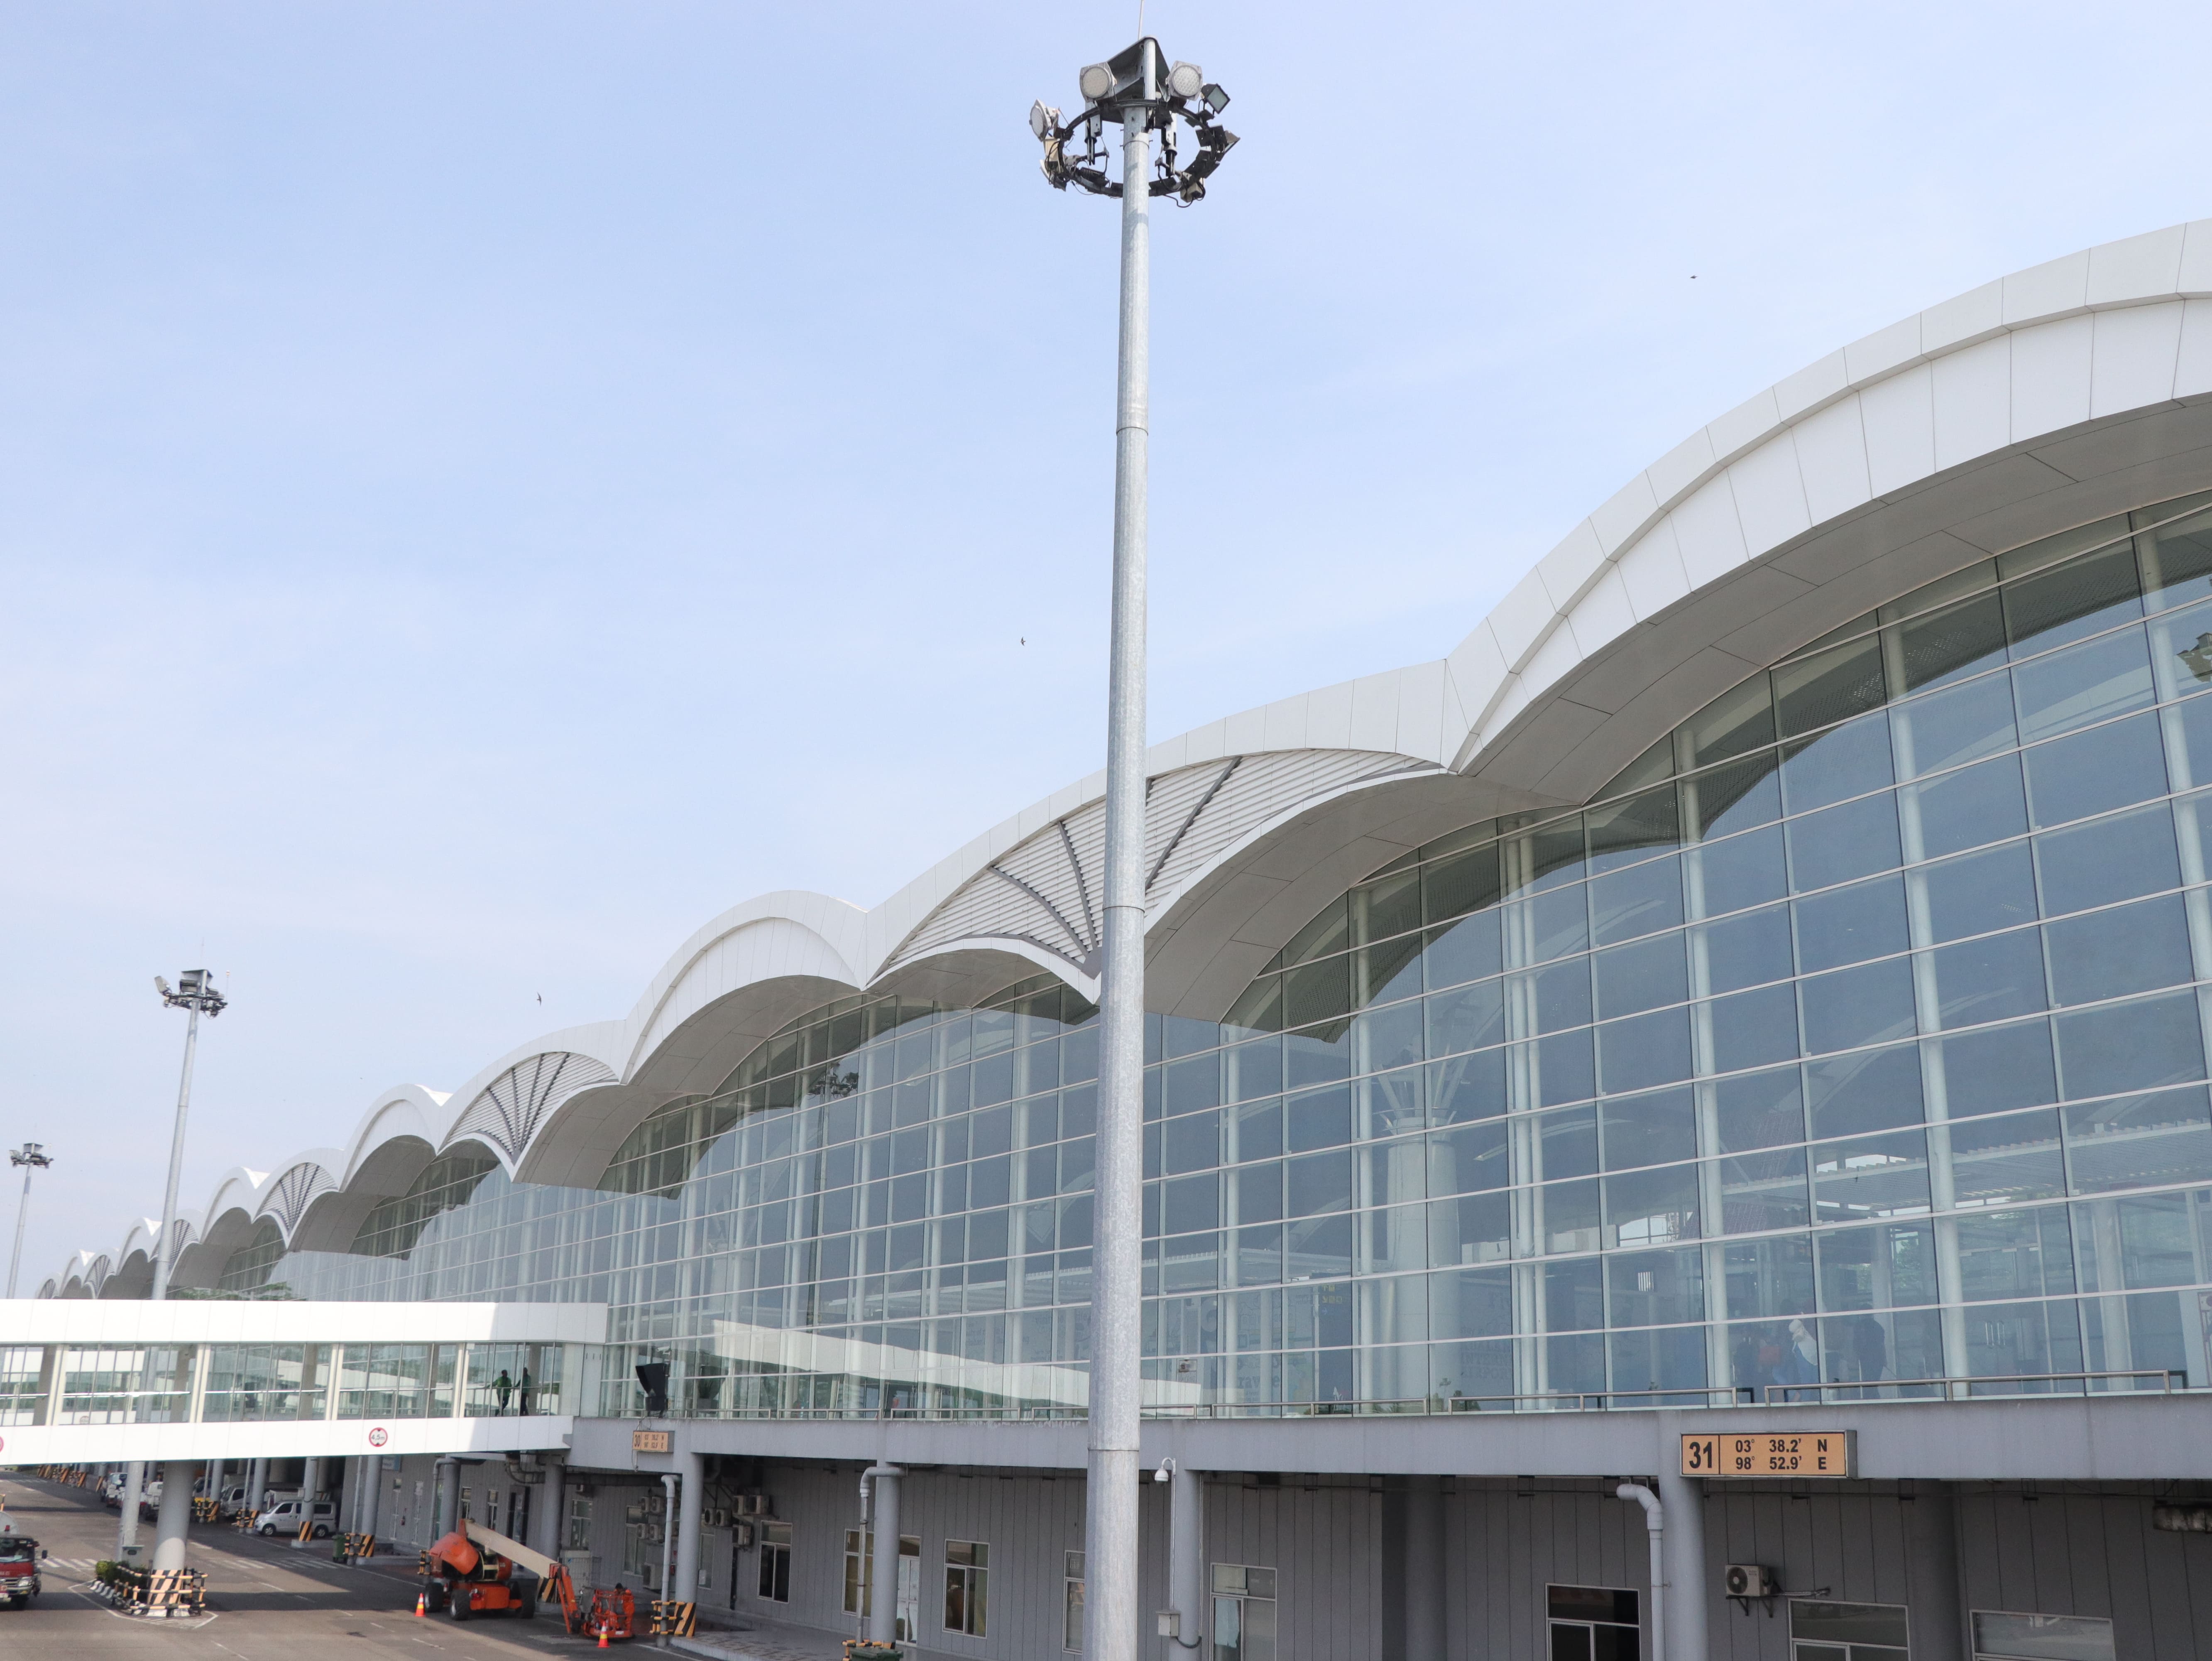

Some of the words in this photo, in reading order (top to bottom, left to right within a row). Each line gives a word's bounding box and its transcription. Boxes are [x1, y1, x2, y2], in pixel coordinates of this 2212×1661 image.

[635, 1435, 640, 1446] 30
[1817, 1439, 1827, 1452] N
[1689, 1441, 1713, 1469] 31
[1818, 1457, 1827, 1470] E
